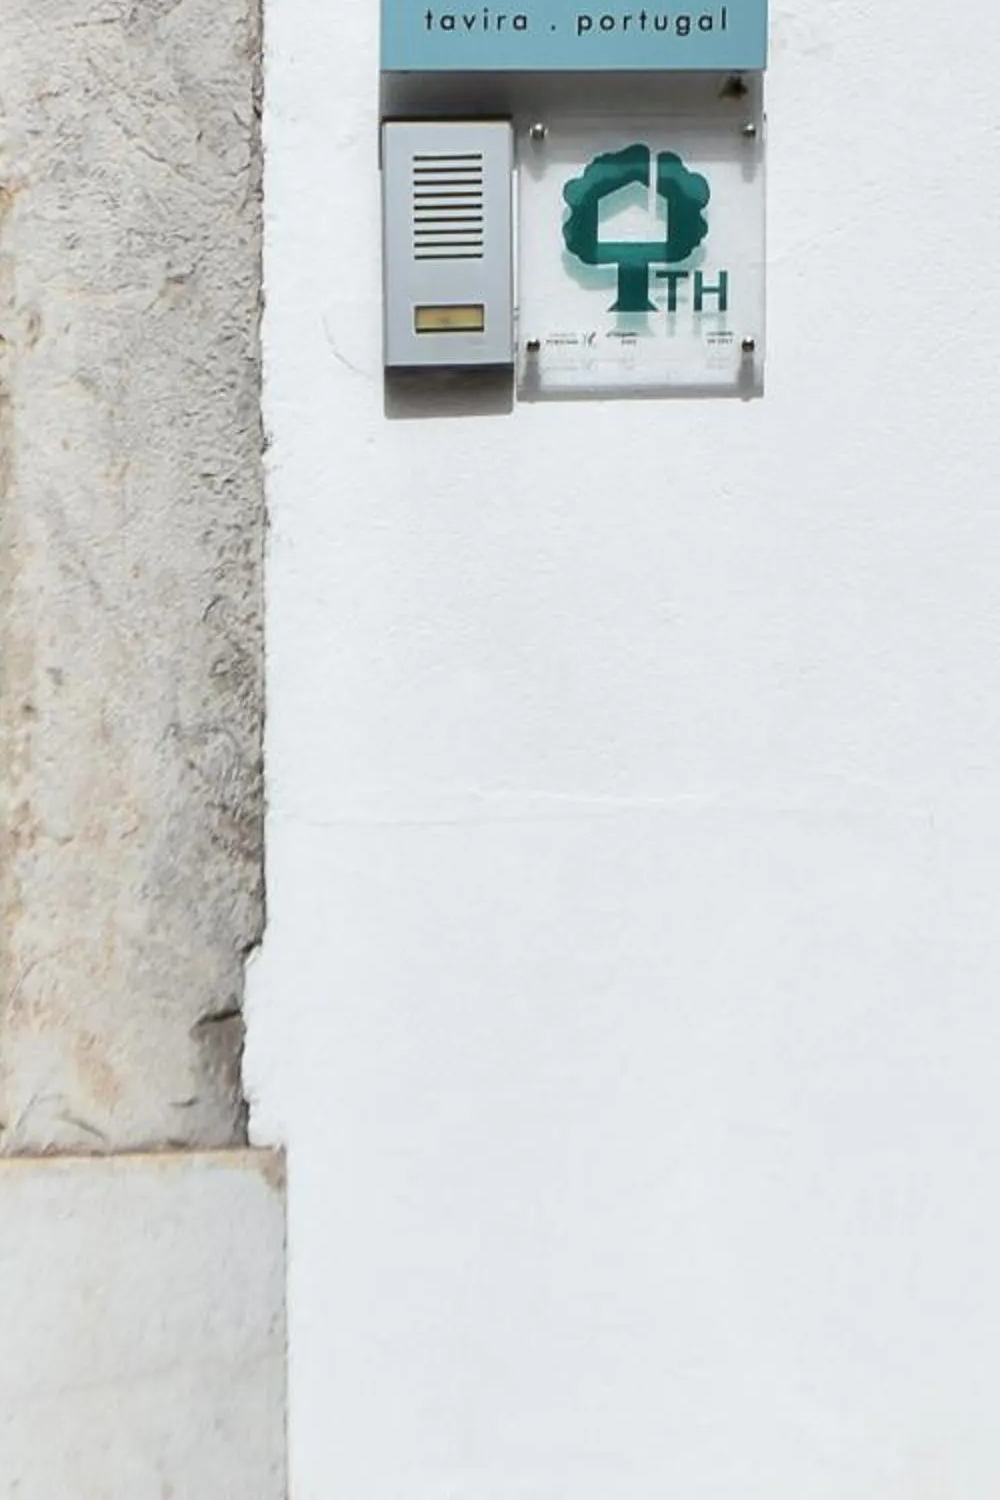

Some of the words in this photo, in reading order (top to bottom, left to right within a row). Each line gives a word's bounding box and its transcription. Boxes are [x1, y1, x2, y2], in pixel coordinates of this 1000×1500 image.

[424, 8, 528, 32] tavira
[577, 7, 728, 37] portugal
[656, 270, 728, 313] TH
